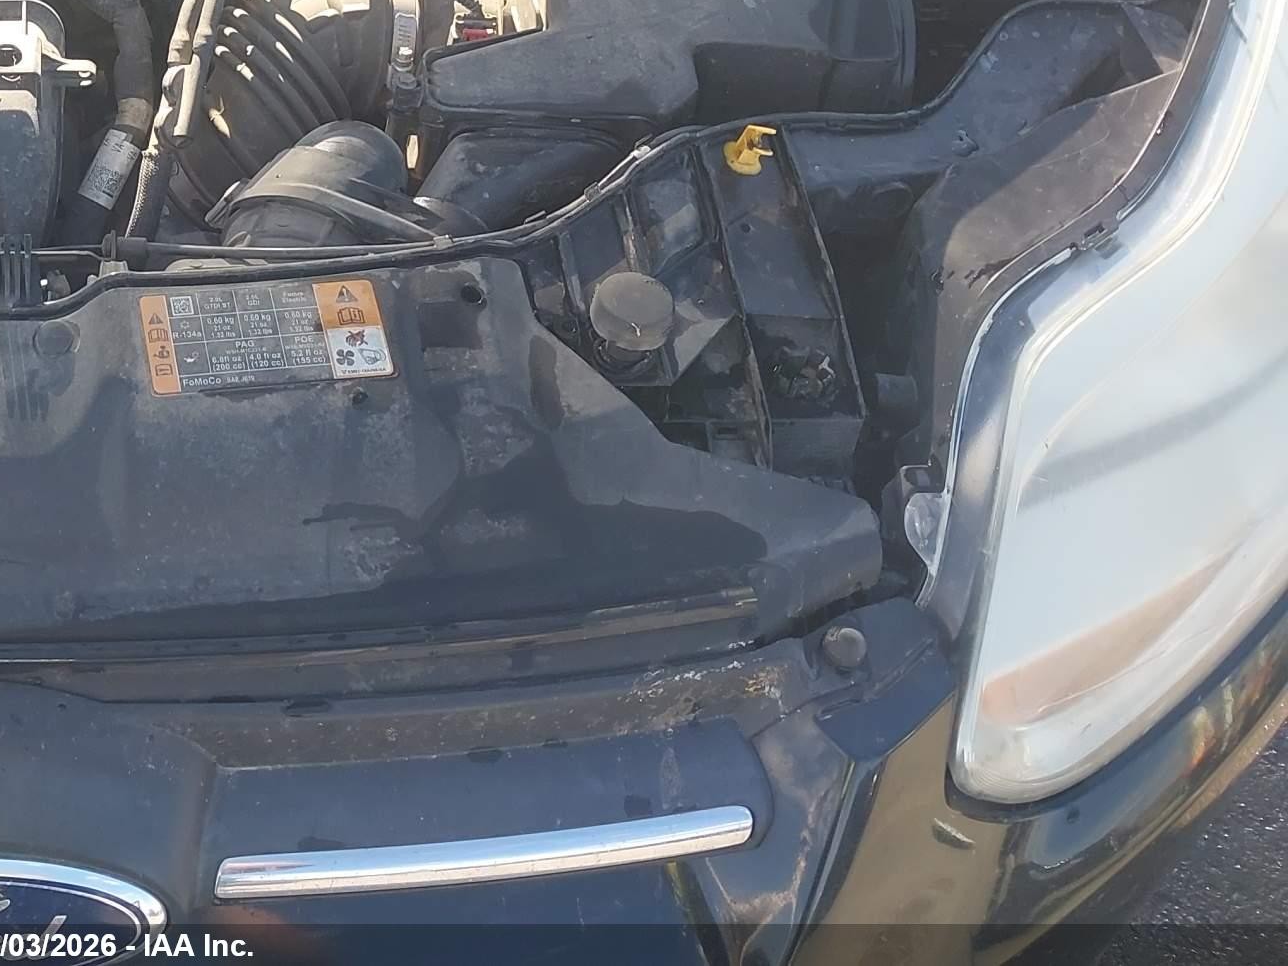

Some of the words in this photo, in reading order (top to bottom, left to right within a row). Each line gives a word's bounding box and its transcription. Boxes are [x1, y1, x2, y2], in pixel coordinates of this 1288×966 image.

[294, 335, 314, 344] POE
[235, 340, 255, 349] PAG
[182, 376, 222, 387] FoMoCo
